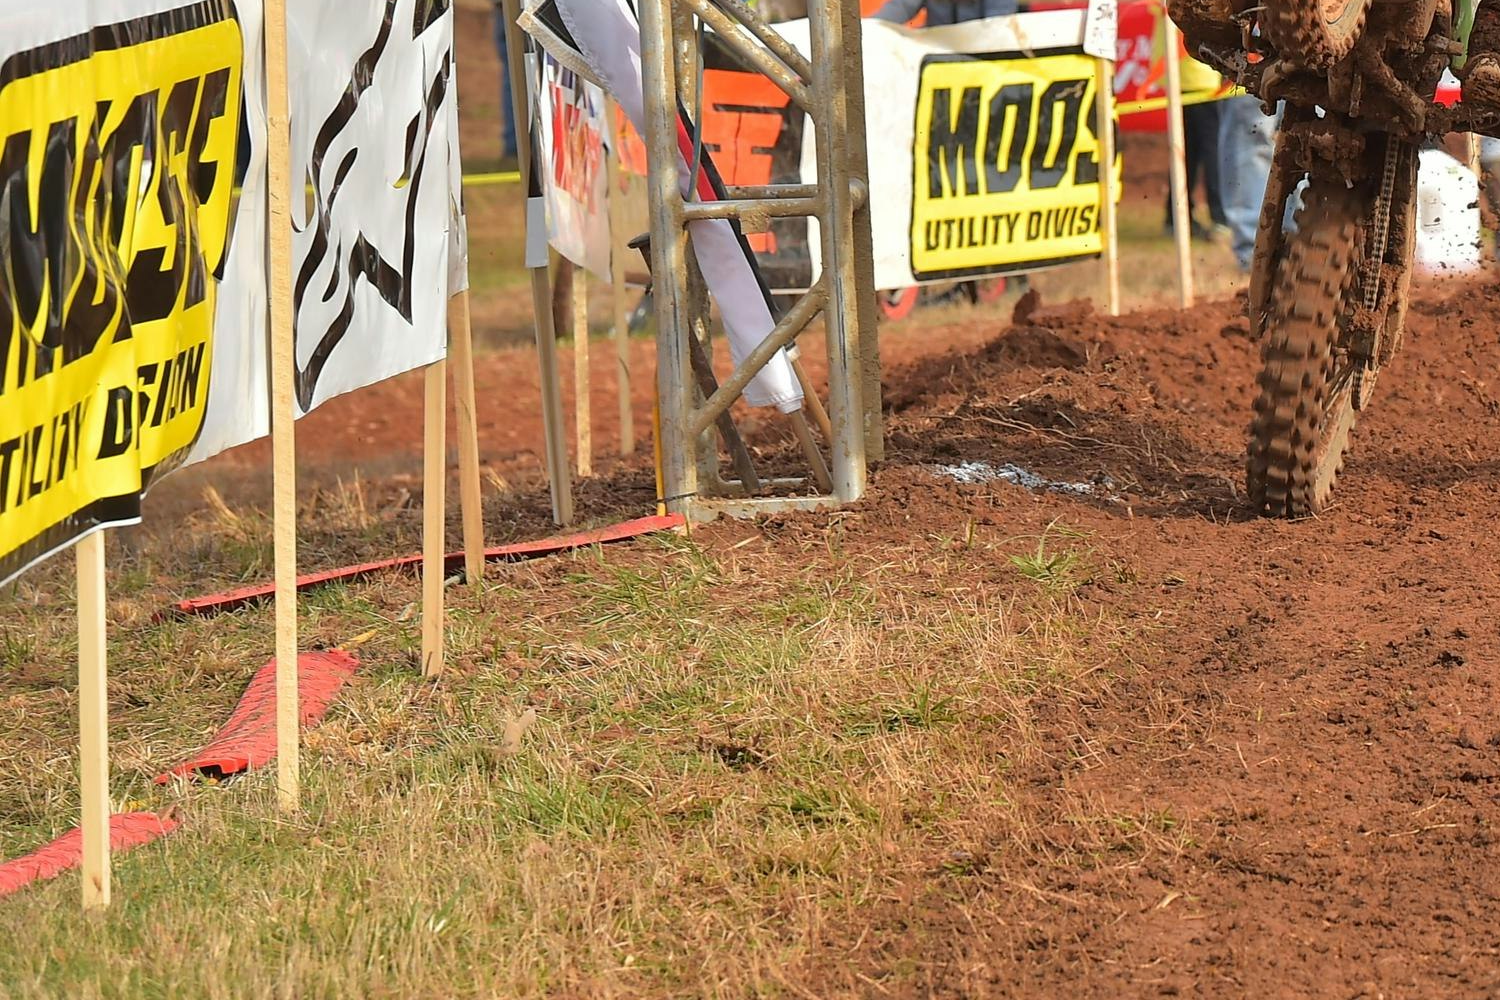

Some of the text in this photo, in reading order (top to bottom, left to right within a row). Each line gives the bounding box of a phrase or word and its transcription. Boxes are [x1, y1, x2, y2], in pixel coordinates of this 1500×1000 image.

[924, 204, 1101, 253] UTILITY DIVIS
[0, 396, 92, 514] TILITY
